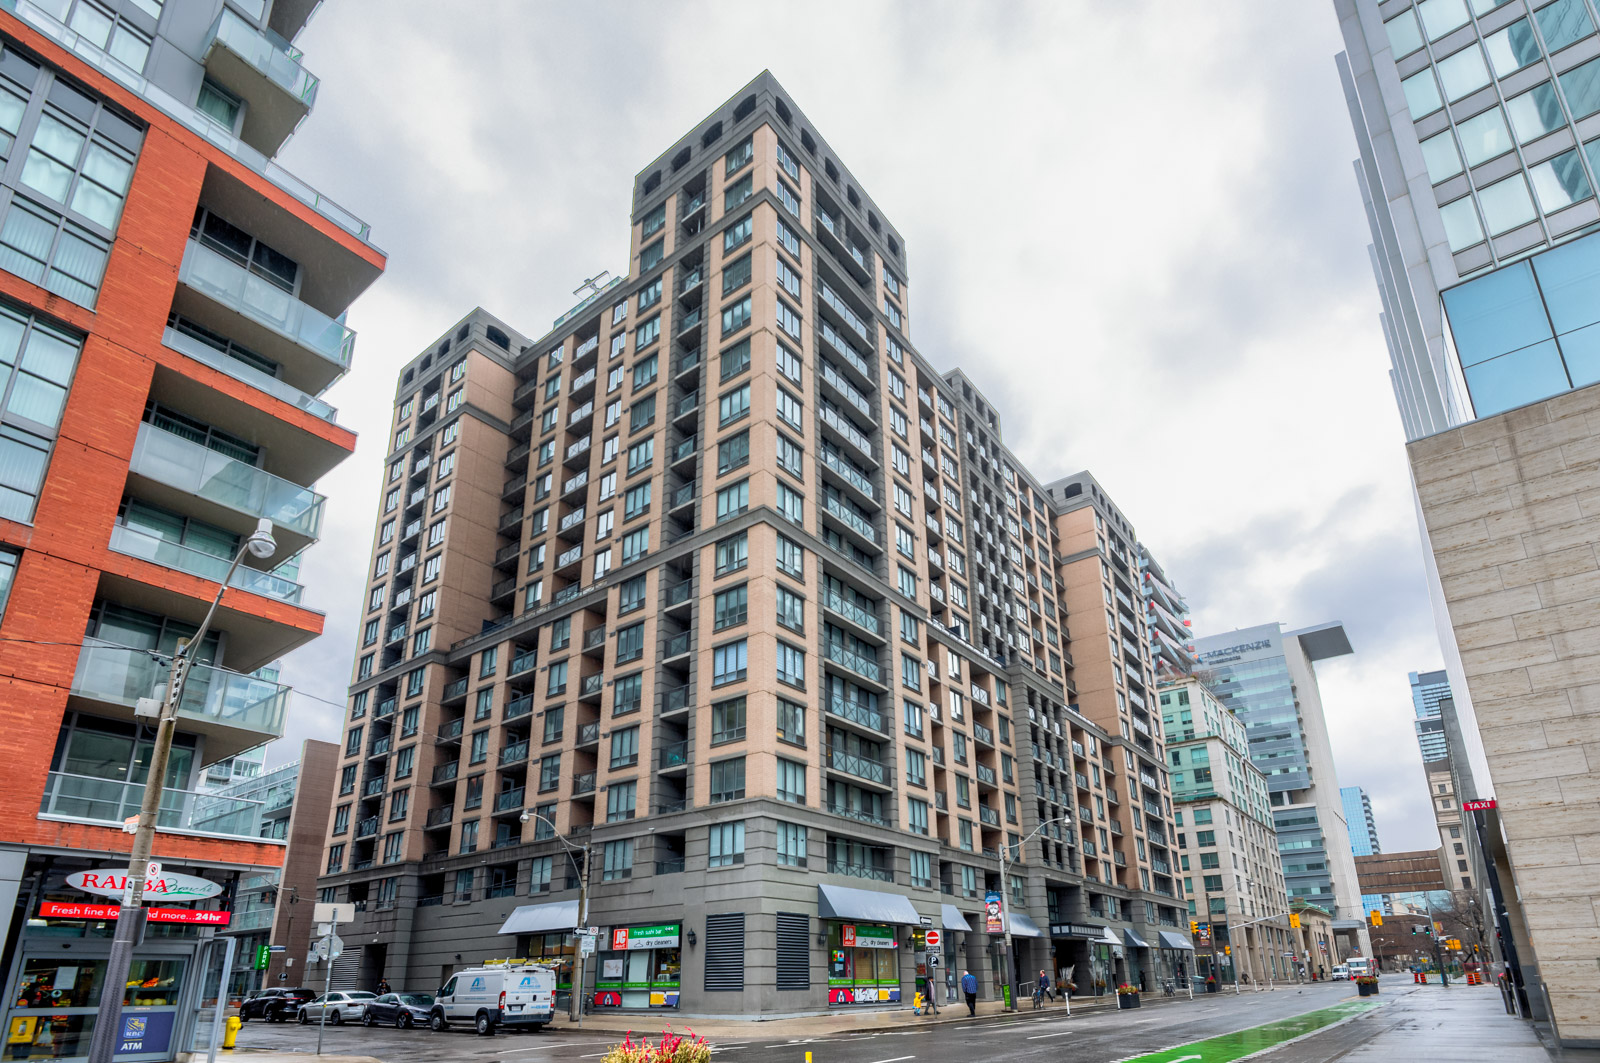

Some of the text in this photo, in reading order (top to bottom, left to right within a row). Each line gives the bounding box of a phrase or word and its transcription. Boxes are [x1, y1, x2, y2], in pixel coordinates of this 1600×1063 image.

[1207, 639, 1272, 658] MACKENZIE
[1468, 801, 1490, 809] TAXI
[51, 905, 80, 914] Fresh
[84, 907, 104, 915] fine
[616, 931, 626, 944] JC
[845, 928, 854, 940] JC
[120, 1042, 142, 1051] ATM
